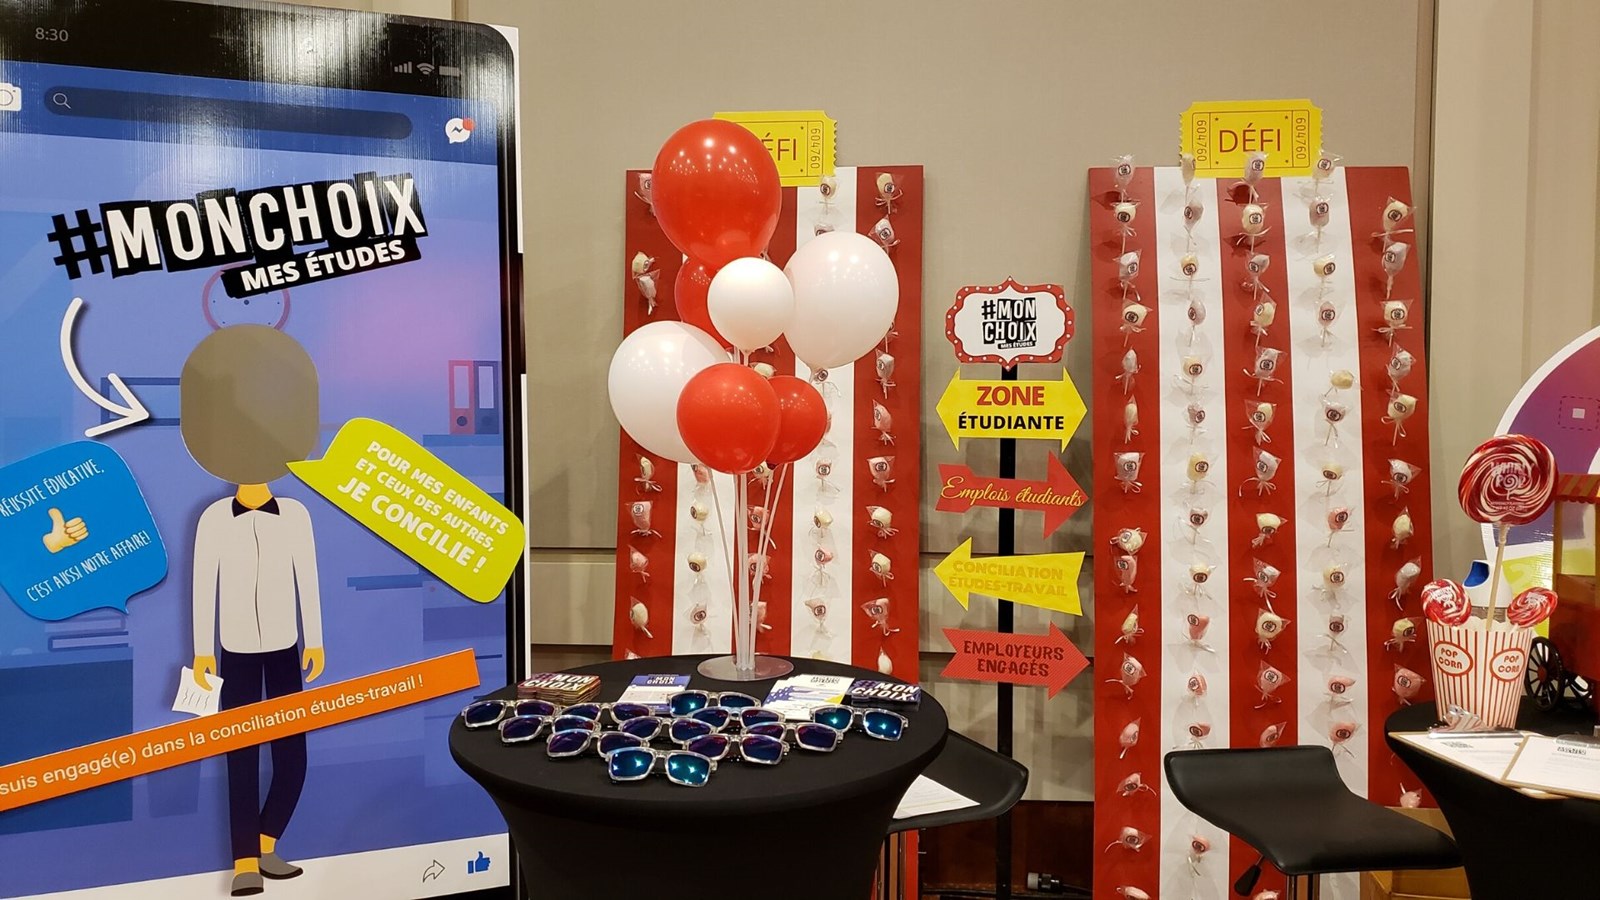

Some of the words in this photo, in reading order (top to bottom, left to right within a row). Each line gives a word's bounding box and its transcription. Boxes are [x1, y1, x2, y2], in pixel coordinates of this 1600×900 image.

[35, 27, 68, 42] 8:30
[810, 128, 821, 169] 604760
[1197, 119, 1207, 162] 604760
[1219, 122, 1281, 153] DÉFI
[1295, 117, 1306, 160] 604760
[47, 178, 425, 280] #MONCHOIX
[240, 261, 300, 292] MES
[304, 239, 406, 278] ÉTUDES
[981, 299, 1037, 320] #MON
[984, 321, 1037, 342] CHOIX
[976, 386, 1045, 406] ZONE
[958, 411, 1065, 430] ÉTUDIANTE
[366, 440, 412, 475] POUR
[410, 468, 444, 495] MES
[443, 488, 509, 535] ENFANTS
[941, 476, 1010, 506] Emplois
[1015, 486, 1085, 508] étudiants
[355, 457, 377, 476] ET
[376, 471, 415, 500] CEUX
[414, 494, 442, 517] DES
[441, 512, 494, 552] AUTRES,
[337, 477, 371, 503] JE
[371, 494, 475, 567] CONCILIE
[26, 580, 53, 602] C'EST
[53, 565, 84, 589] AUSSI
[80, 551, 112, 575] NOTRE
[109, 530, 152, 560] AFFAIRE!
[952, 560, 1063, 581] CONCILIATION
[949, 574, 1067, 597] ÉTUDES-TRAVAIL
[963, 640, 1064, 661] EMPLOYEURS
[1440, 647, 1458, 658] POP
[977, 658, 1049, 678] ENGAGÉS
[1438, 657, 1463, 669] CORN
[525, 680, 582, 691] CHOIX
[851, 687, 912, 700] CHOIX
[0, 775, 38, 795] suis
[42, 747, 137, 785] engagé(e)
[141, 737, 186, 759] dans
[189, 731, 206, 746] la
[210, 705, 307, 741] conciliation
[310, 677, 416, 715] études-travail
